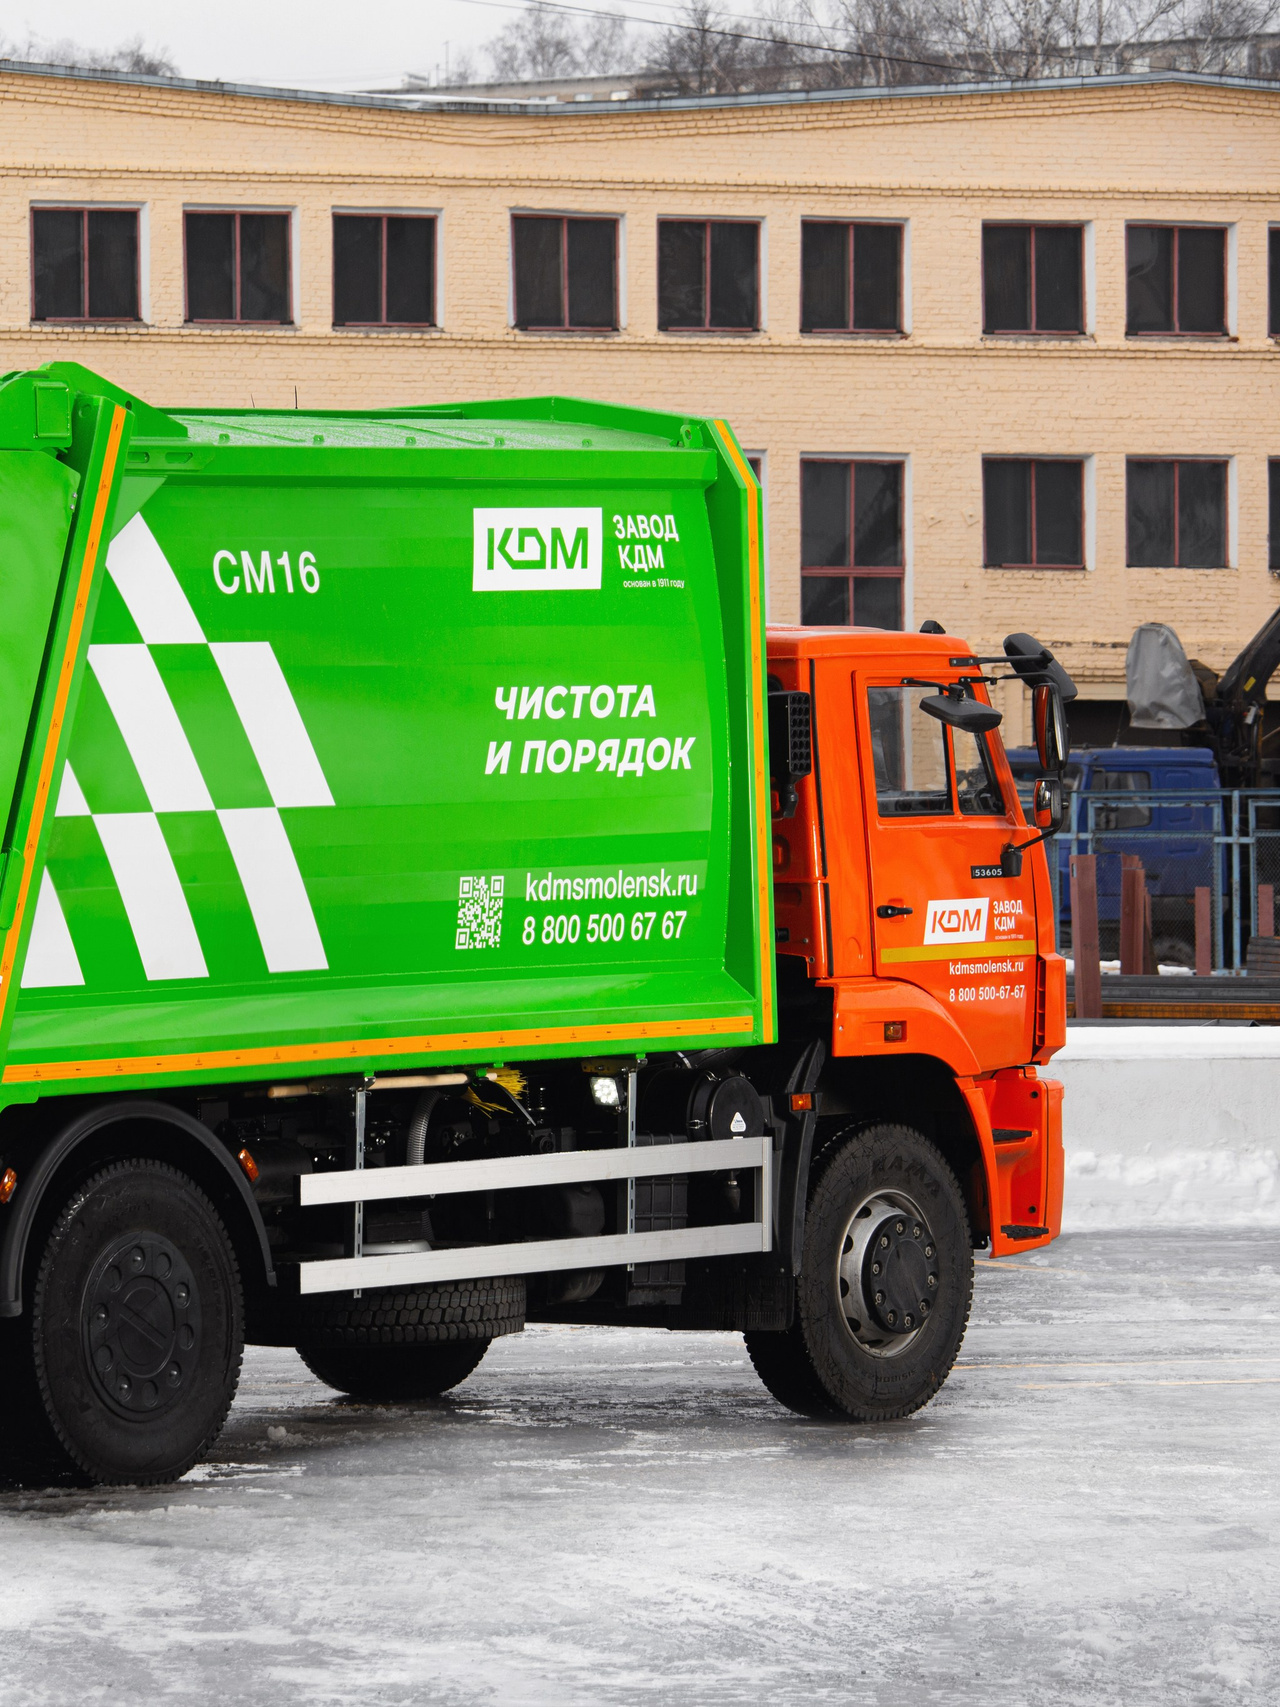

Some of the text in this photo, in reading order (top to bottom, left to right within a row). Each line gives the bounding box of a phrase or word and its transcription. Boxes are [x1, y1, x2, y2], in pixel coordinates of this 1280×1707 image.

[612, 514, 680, 542] ЗАВОД
[618, 544, 665, 572] КДМ
[623, 580, 651, 588] основан
[652, 580, 657, 588] в
[670, 579, 685, 589] году
[494, 684, 657, 720] ЧИСТОТА
[484, 737, 696, 778] И ПОРЯДОК
[975, 868, 1003, 877] 53605
[525, 868, 698, 902] kdmsmolensk.ru
[993, 899, 1023, 915] ЗАВОД
[522, 910, 687, 945] 8 800 500 67 67
[993, 915, 1016, 931] КДМ
[949, 959, 1024, 975] kdmsmolensk.ru
[949, 984, 1025, 1002] 8 800 500-67-67
